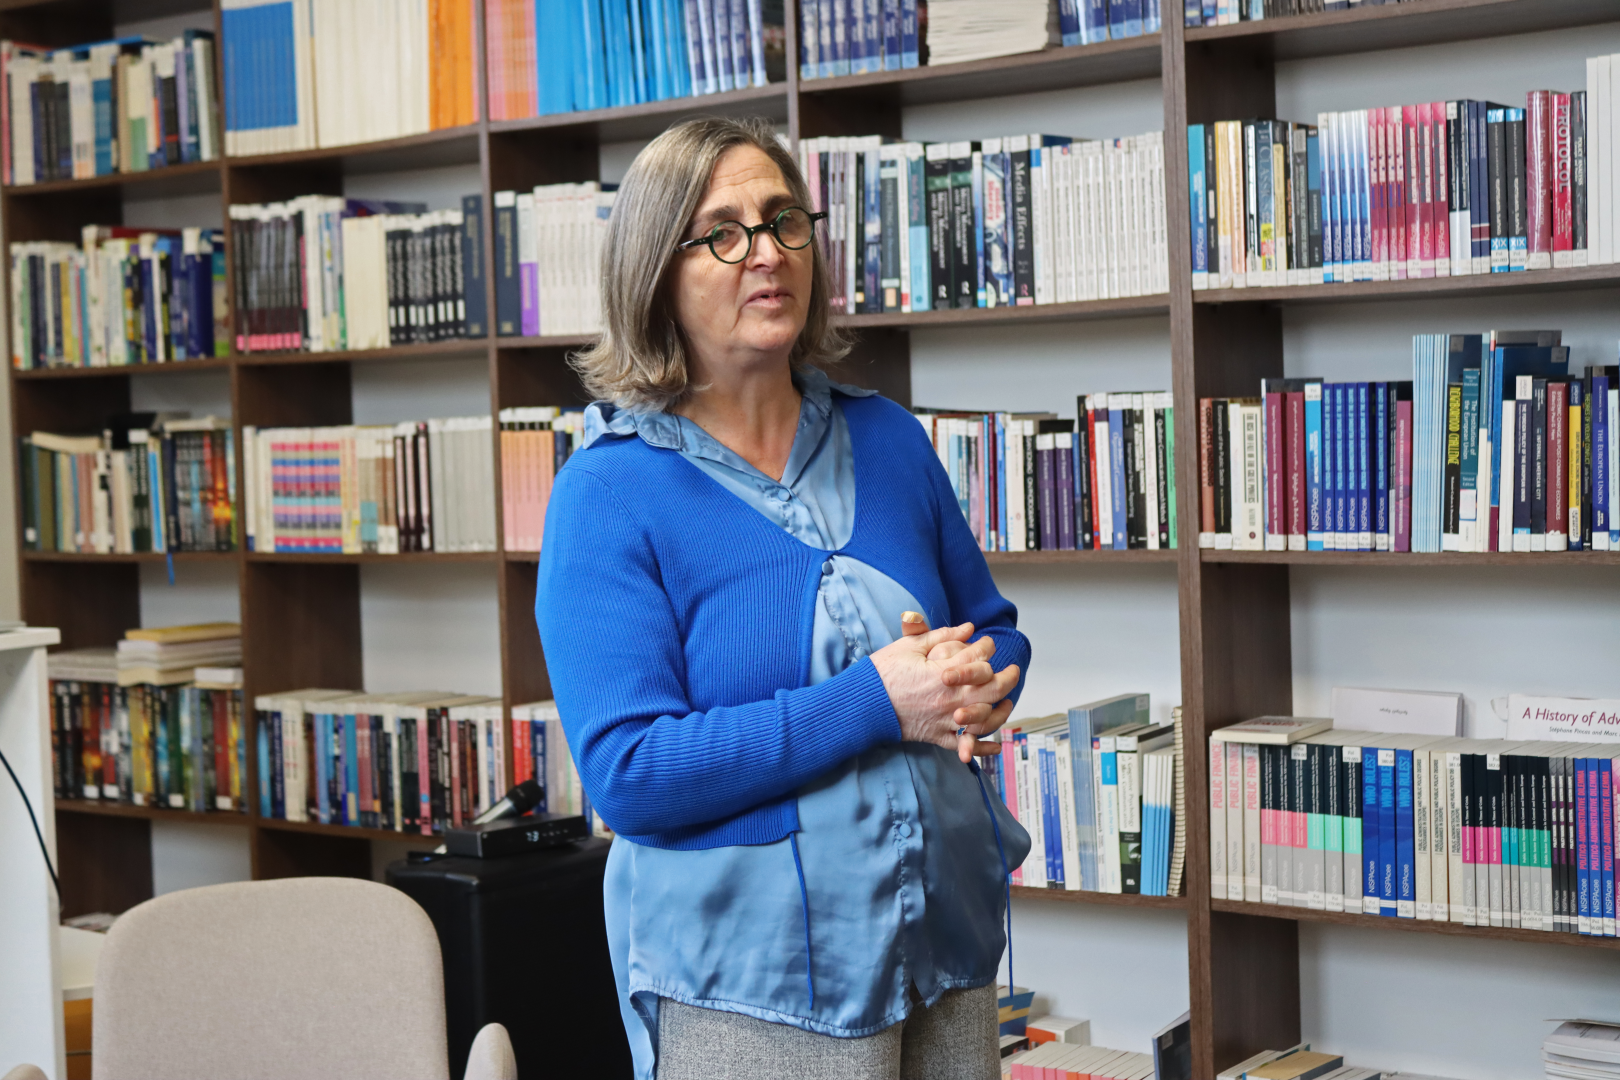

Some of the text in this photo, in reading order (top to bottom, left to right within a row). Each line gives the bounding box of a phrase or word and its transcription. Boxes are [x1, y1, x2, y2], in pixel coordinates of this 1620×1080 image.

[1558, 105, 1570, 193] PROTOCOL
[1014, 162, 1028, 250] Media Effects
[1522, 707, 1531, 719] A
[1535, 708, 1579, 726] History
[1582, 711, 1597, 726] of
[1212, 743, 1223, 809] PUBLIC FINANCE
[1229, 742, 1239, 809] PUBLIC FINANCE
[1247, 781, 1257, 810] PUBLIC
[1365, 754, 1376, 805] WHO RULES?
[1381, 766, 1392, 808] WHO RULE
[1399, 756, 1410, 808] WHO RULES?
[1577, 770, 1587, 870] POLITICO-ADMINISTRATIVE DILEMMA
[1589, 771, 1599, 870] POLITICO-ADMINISTRATIVE DILEMMA
[1602, 771, 1612, 871] POLITICO-ADMINISTRATIVE DILEMMA
[1580, 878, 1588, 912] NISPAcee
